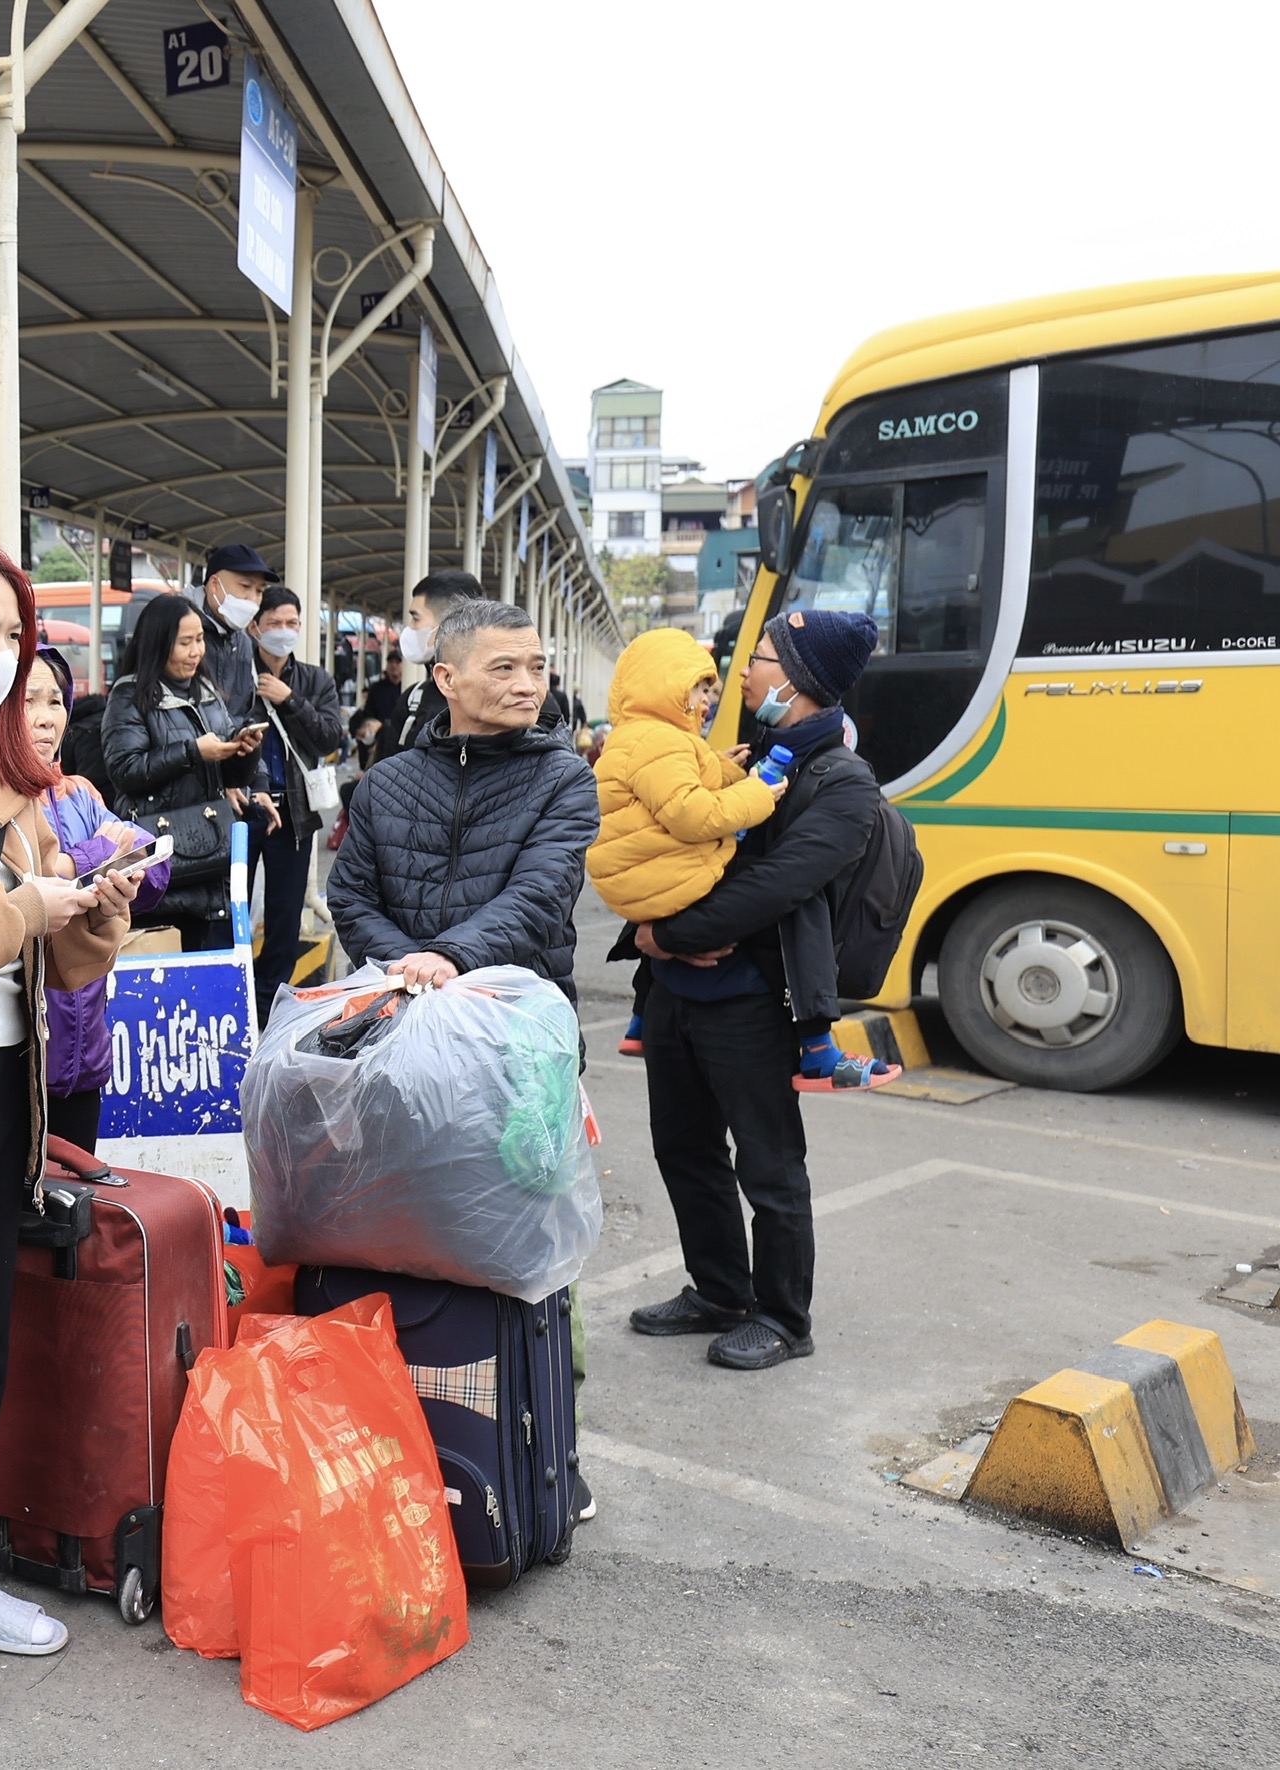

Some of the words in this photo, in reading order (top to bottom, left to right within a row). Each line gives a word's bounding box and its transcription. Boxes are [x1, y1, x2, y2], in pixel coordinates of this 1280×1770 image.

[168, 32, 187, 49] A1
[177, 45, 222, 87] 20
[878, 410, 979, 441] SAMCO
[1042, 641, 1096, 655] Powered
[1097, 641, 1113, 654] by
[1115, 638, 1186, 653] ISUZU
